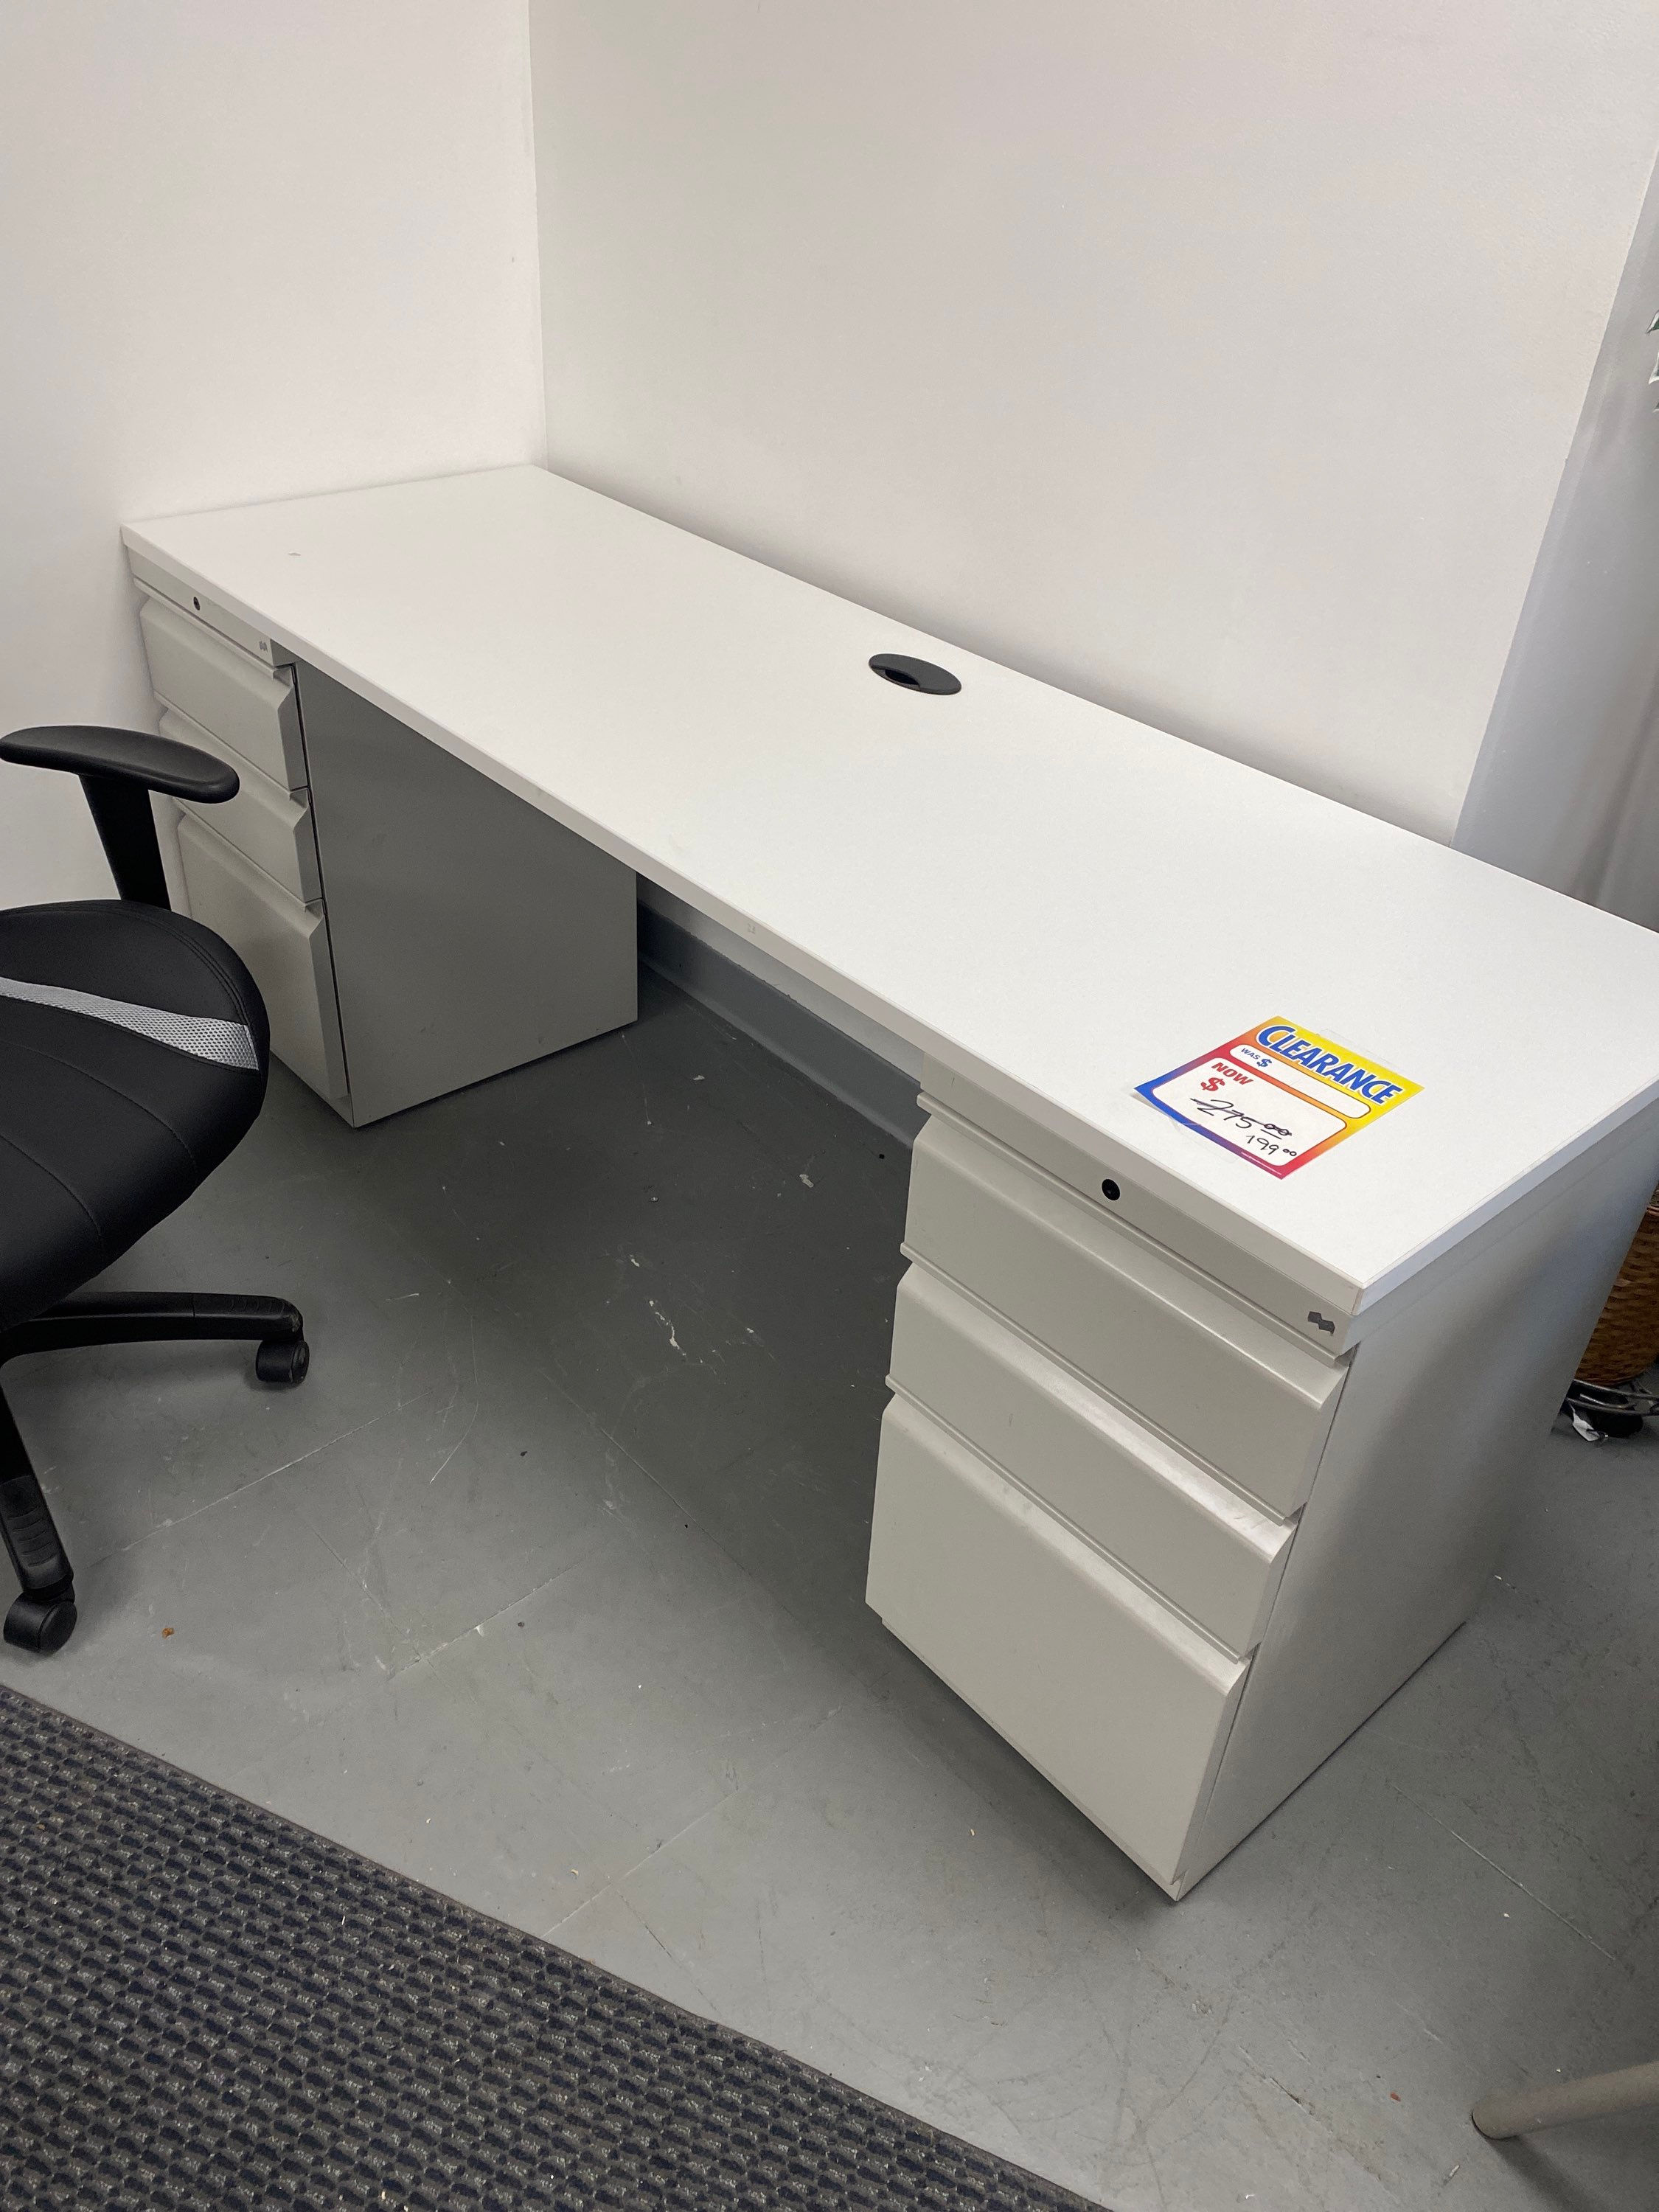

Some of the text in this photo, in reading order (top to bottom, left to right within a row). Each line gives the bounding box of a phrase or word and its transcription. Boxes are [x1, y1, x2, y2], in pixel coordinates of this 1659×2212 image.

[1241, 1048, 1272, 1068] WAS $
[1256, 1026, 1402, 1103] CLEARANCE
[1200, 1077, 1225, 1091] $
[1211, 1062, 1253, 1085] NOW
